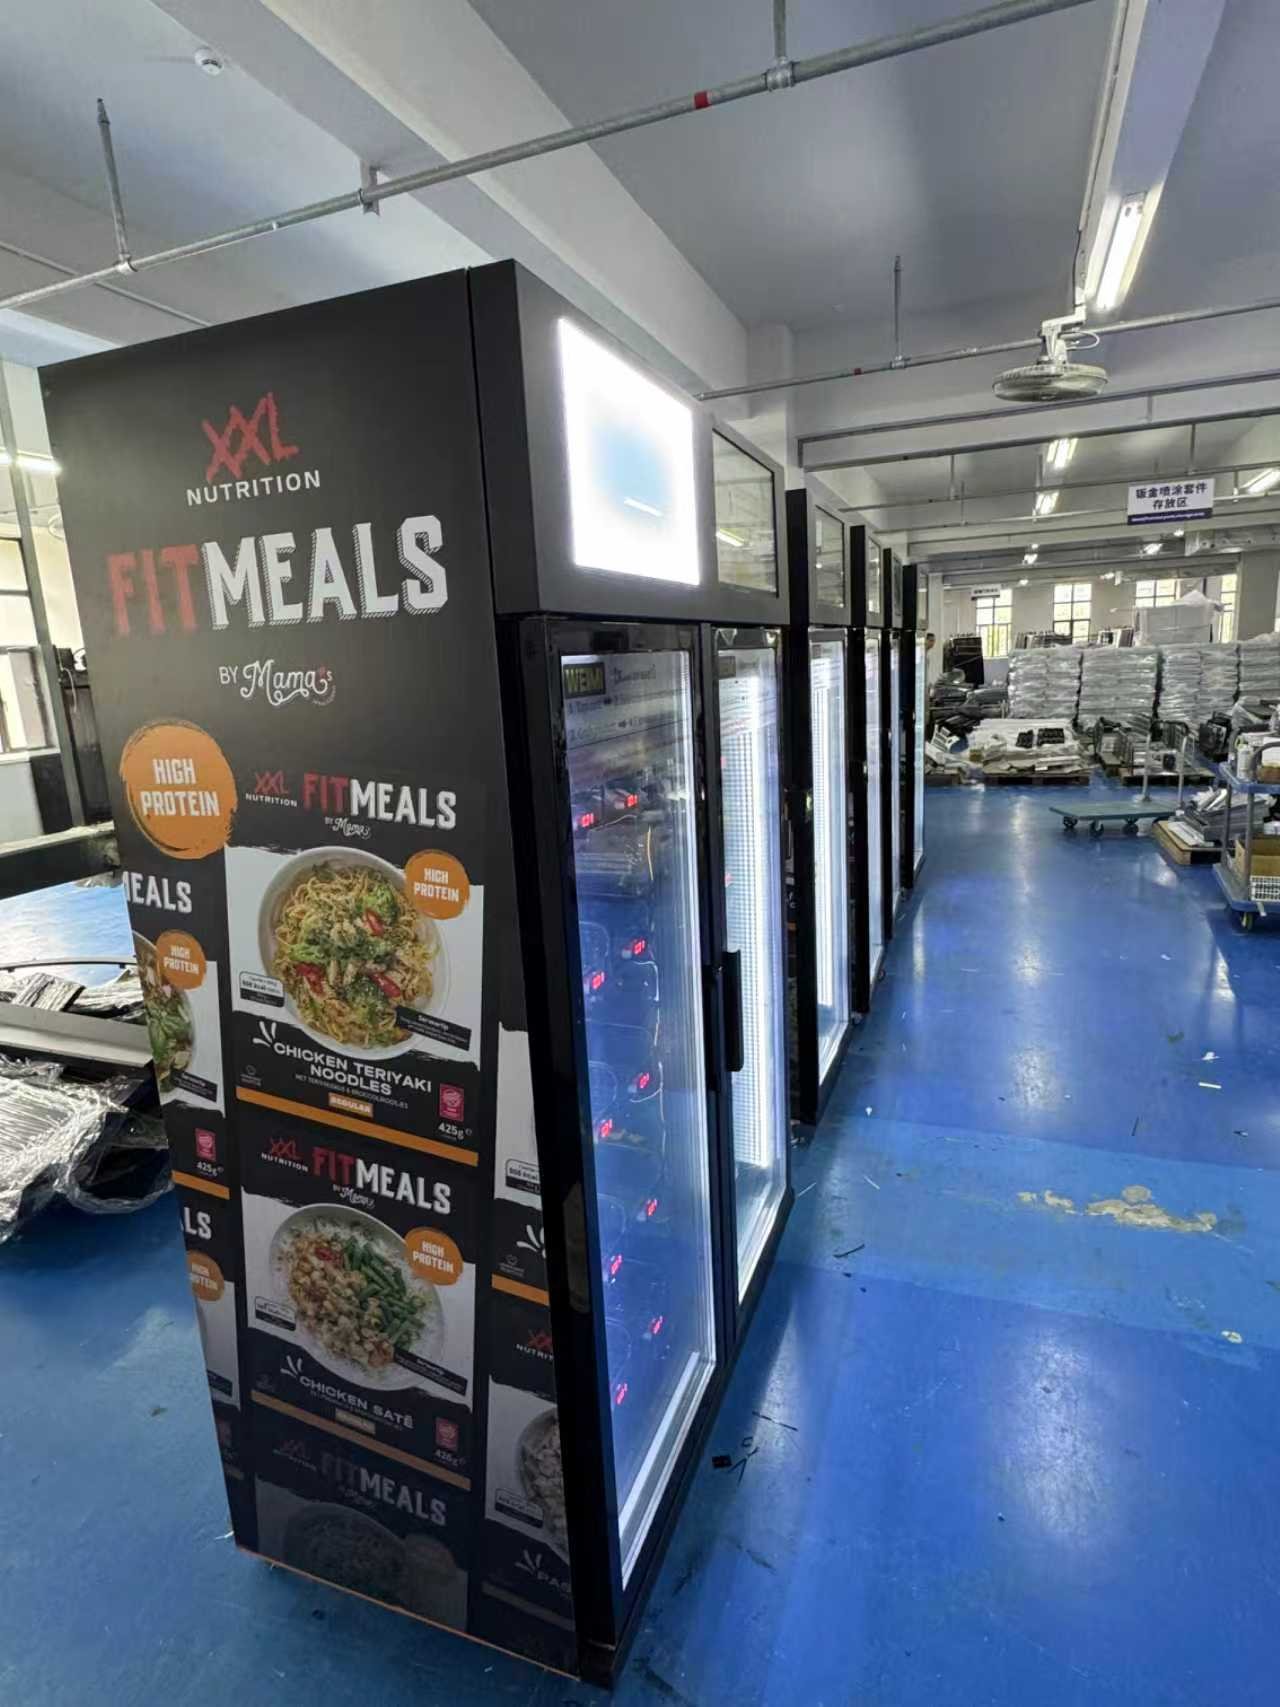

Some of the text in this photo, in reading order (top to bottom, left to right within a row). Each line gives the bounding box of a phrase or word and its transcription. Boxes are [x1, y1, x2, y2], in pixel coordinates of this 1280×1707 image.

[202, 392, 299, 483] XXL
[186, 470, 322, 506] NUTRITION
[1152, 497, 1189, 510] 存放区
[105, 514, 449, 637] FITMEALS
[218, 665, 239, 686] BY
[152, 758, 196, 785] HIGH
[254, 770, 290, 794] XXL
[139, 790, 220, 817] PROTEIN
[245, 793, 298, 807] NUTRITION
[302, 771, 457, 831] FITMEALS
[423, 867, 449, 884] HIGH
[413, 881, 460, 903] PROTEIN
[170, 944, 191, 958] HIGH
[162, 956, 200, 975] PROTEIN
[273, 1040, 349, 1071] CHICKEN
[353, 1061, 433, 1093] TERIYAKI
[310, 1065, 393, 1096] NOODLES
[260, 1152, 309, 1172] NUTRITION
[421, 1240, 445, 1259] HIGH
[412, 1251, 455, 1274] PROTEIN
[299, 1376, 369, 1410] CHICKEN
